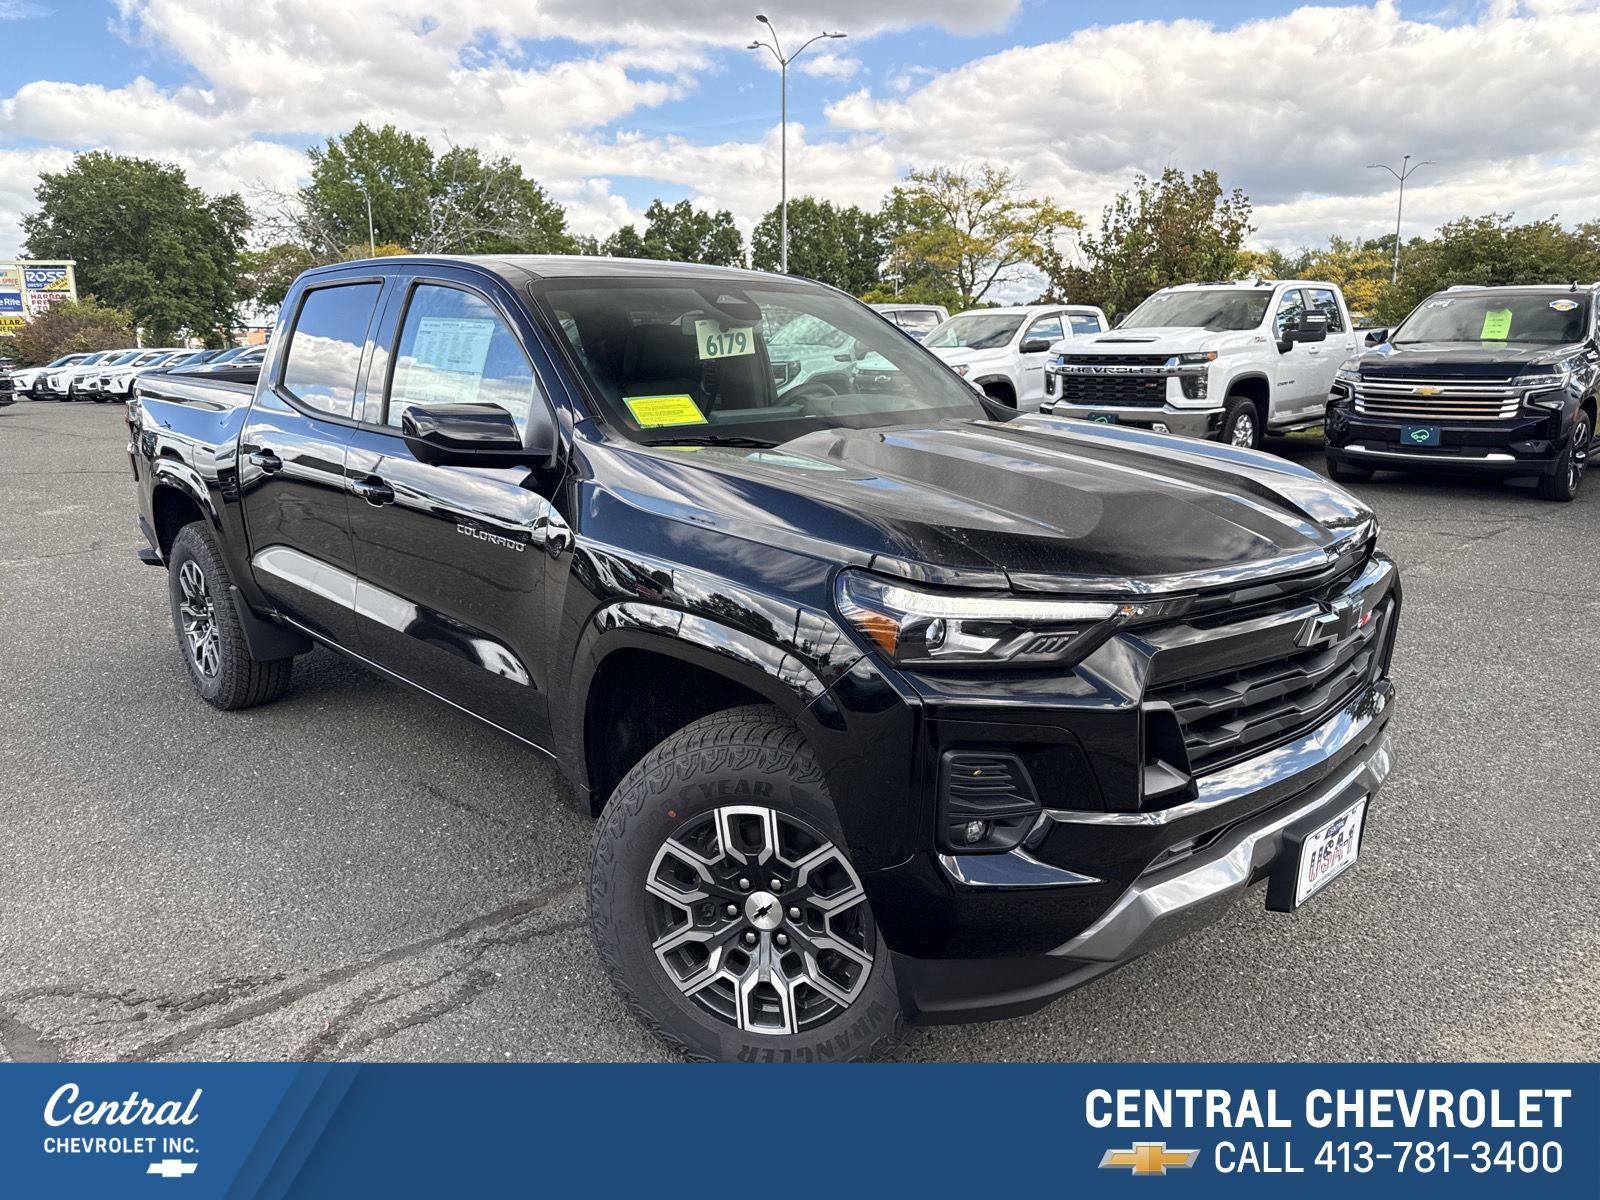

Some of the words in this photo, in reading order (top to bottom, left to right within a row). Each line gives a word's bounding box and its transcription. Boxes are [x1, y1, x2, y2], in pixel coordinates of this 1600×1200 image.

[25, 271, 66, 282] ROSS
[4, 298, 21, 306] Rite
[706, 332, 747, 356] 6179
[1062, 366, 1165, 374] CHEVROLET
[456, 523, 527, 553] COLORADO
[1308, 824, 1355, 882] USA-1
